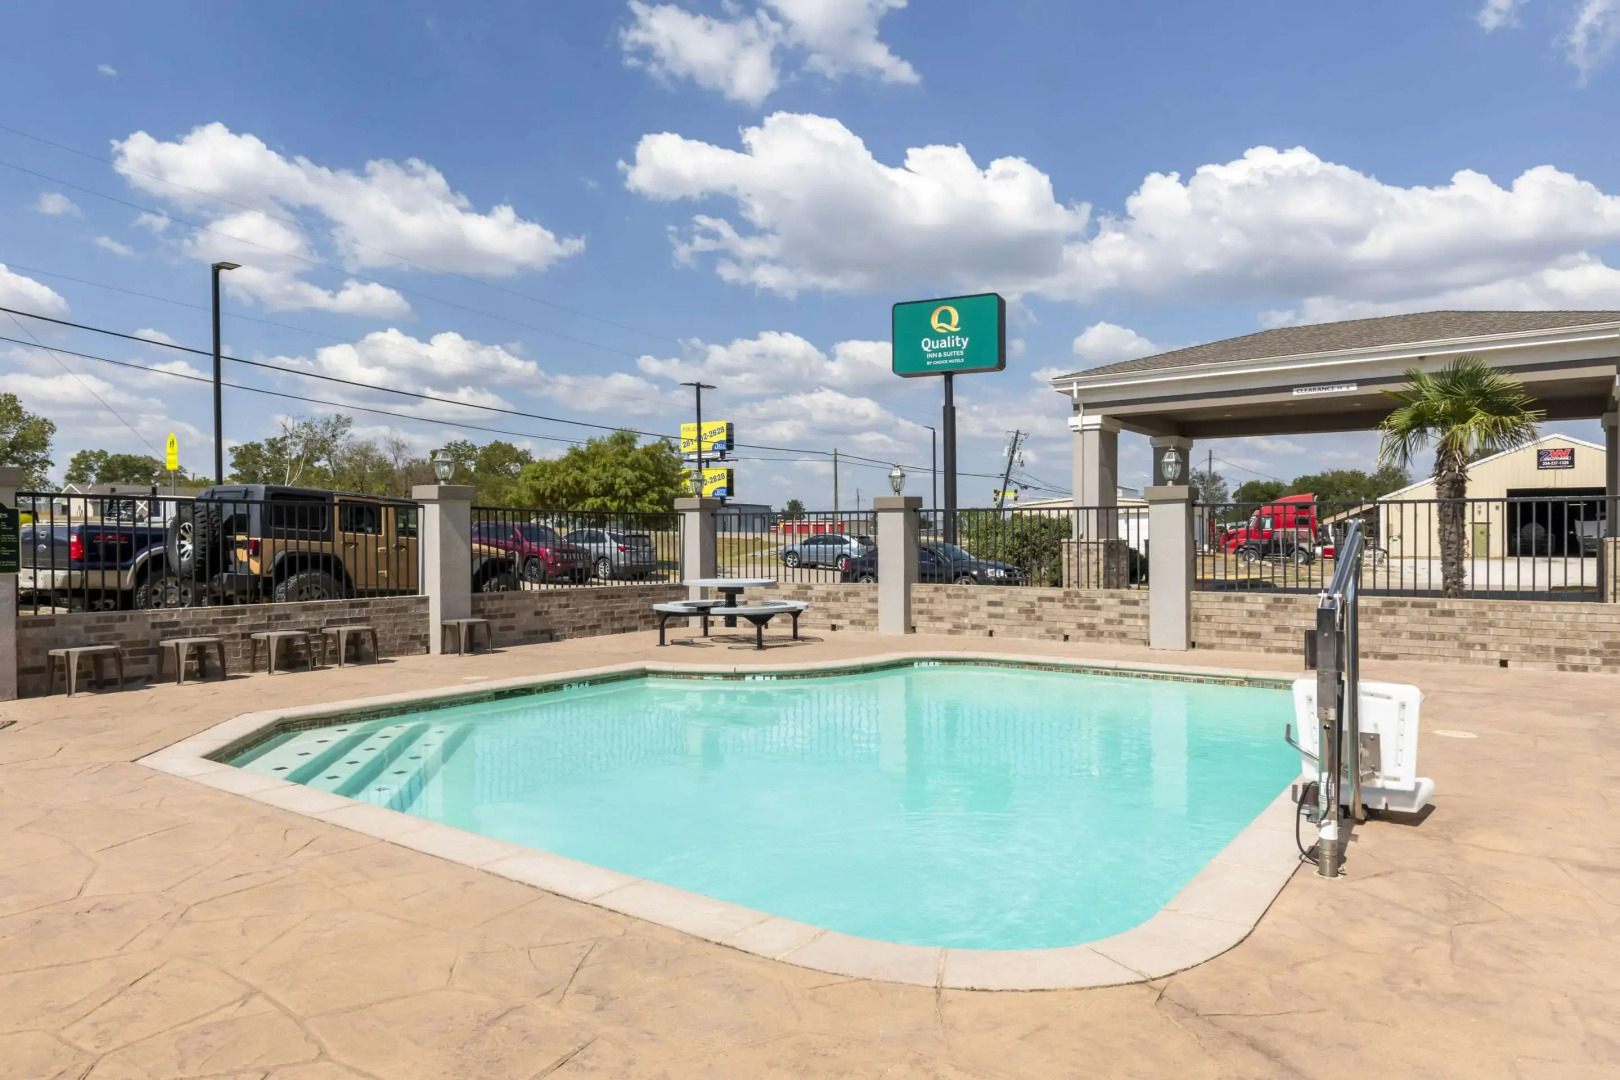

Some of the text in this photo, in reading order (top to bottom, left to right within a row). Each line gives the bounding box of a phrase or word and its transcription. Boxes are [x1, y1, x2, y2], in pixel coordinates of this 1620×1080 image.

[930, 305, 961, 333] Q
[921, 336, 969, 352] Quality
[1296, 385, 1334, 394] CLEARANCE
